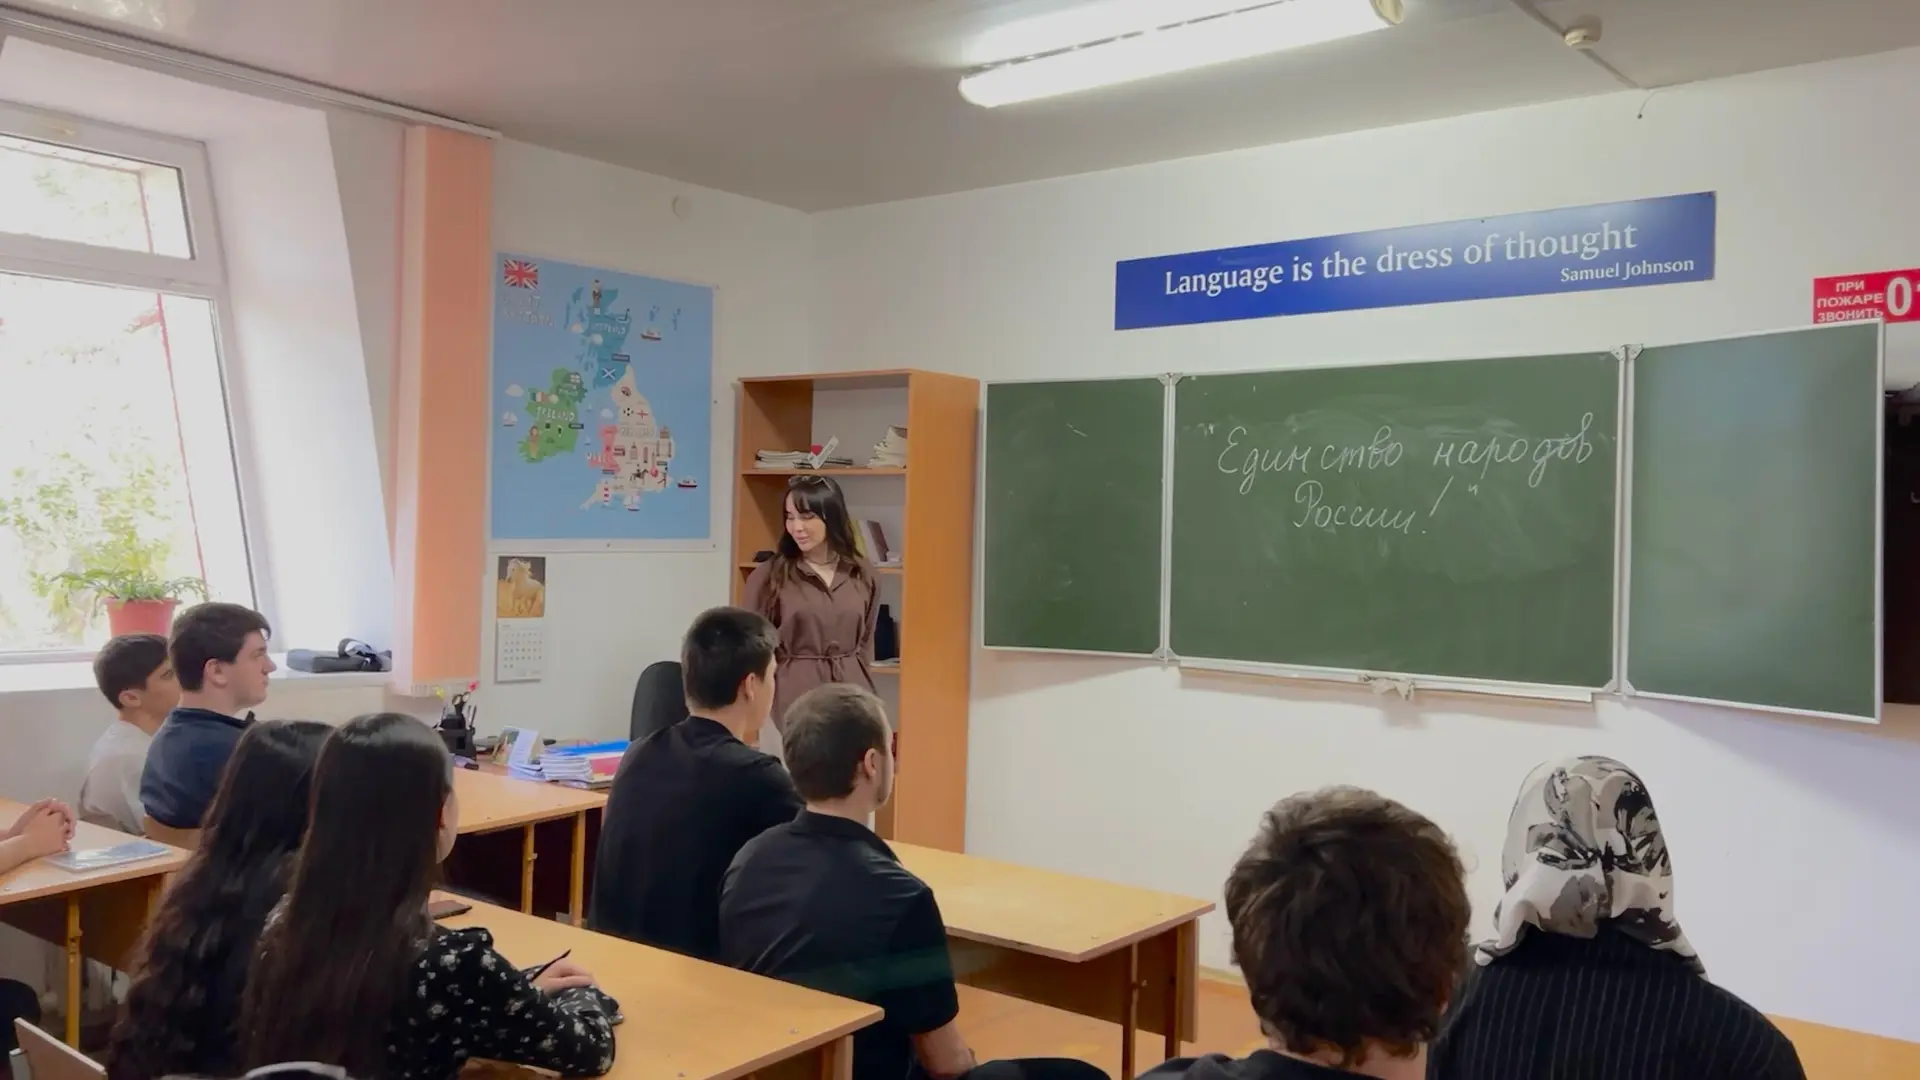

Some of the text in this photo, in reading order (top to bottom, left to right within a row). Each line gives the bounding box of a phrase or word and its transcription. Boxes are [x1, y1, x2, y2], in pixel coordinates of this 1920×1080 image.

[1165, 221, 1639, 297] Language is the dress of thought
[1560, 259, 1695, 282] Samuel Johnson
[1835, 280, 1865, 293] ПРИ
[1886, 276, 1920, 317] 0
[1816, 293, 1884, 309] ПОЖАРЕ
[1817, 307, 1884, 323] ЗВОНИТЬ
[1432, 412, 1594, 488] народов
